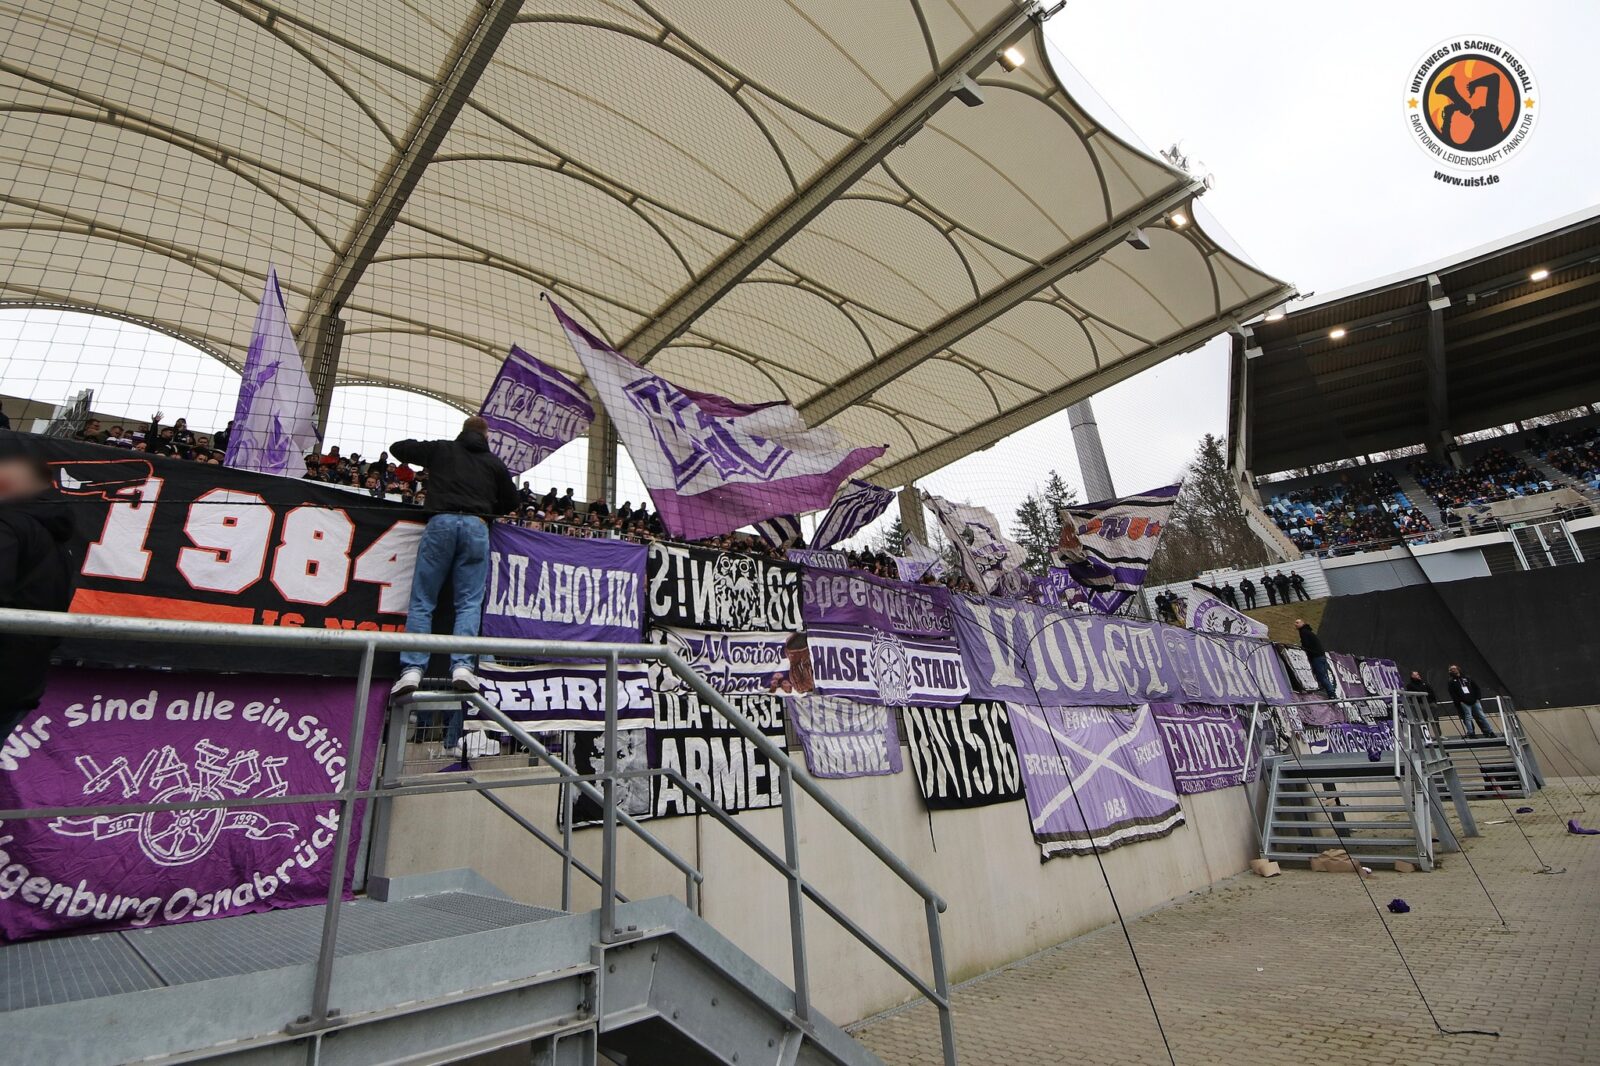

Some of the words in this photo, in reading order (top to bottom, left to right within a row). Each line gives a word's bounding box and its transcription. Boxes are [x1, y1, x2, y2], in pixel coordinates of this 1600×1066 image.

[80, 476, 426, 615] 1984
[811, 645, 870, 682] HASE
[911, 655, 968, 690] STADT
[963, 601, 1170, 696] VIOLET
[0, 715, 52, 771] Wir
[64, 690, 159, 728] sind
[165, 691, 235, 721] alle
[242, 698, 292, 733] ein
[1160, 722, 1245, 773] EIMER
[1024, 753, 1075, 778] BREMER
[107, 818, 135, 834] SEIT
[0, 820, 162, 925] genburg
[163, 808, 341, 921] Osnabrück
